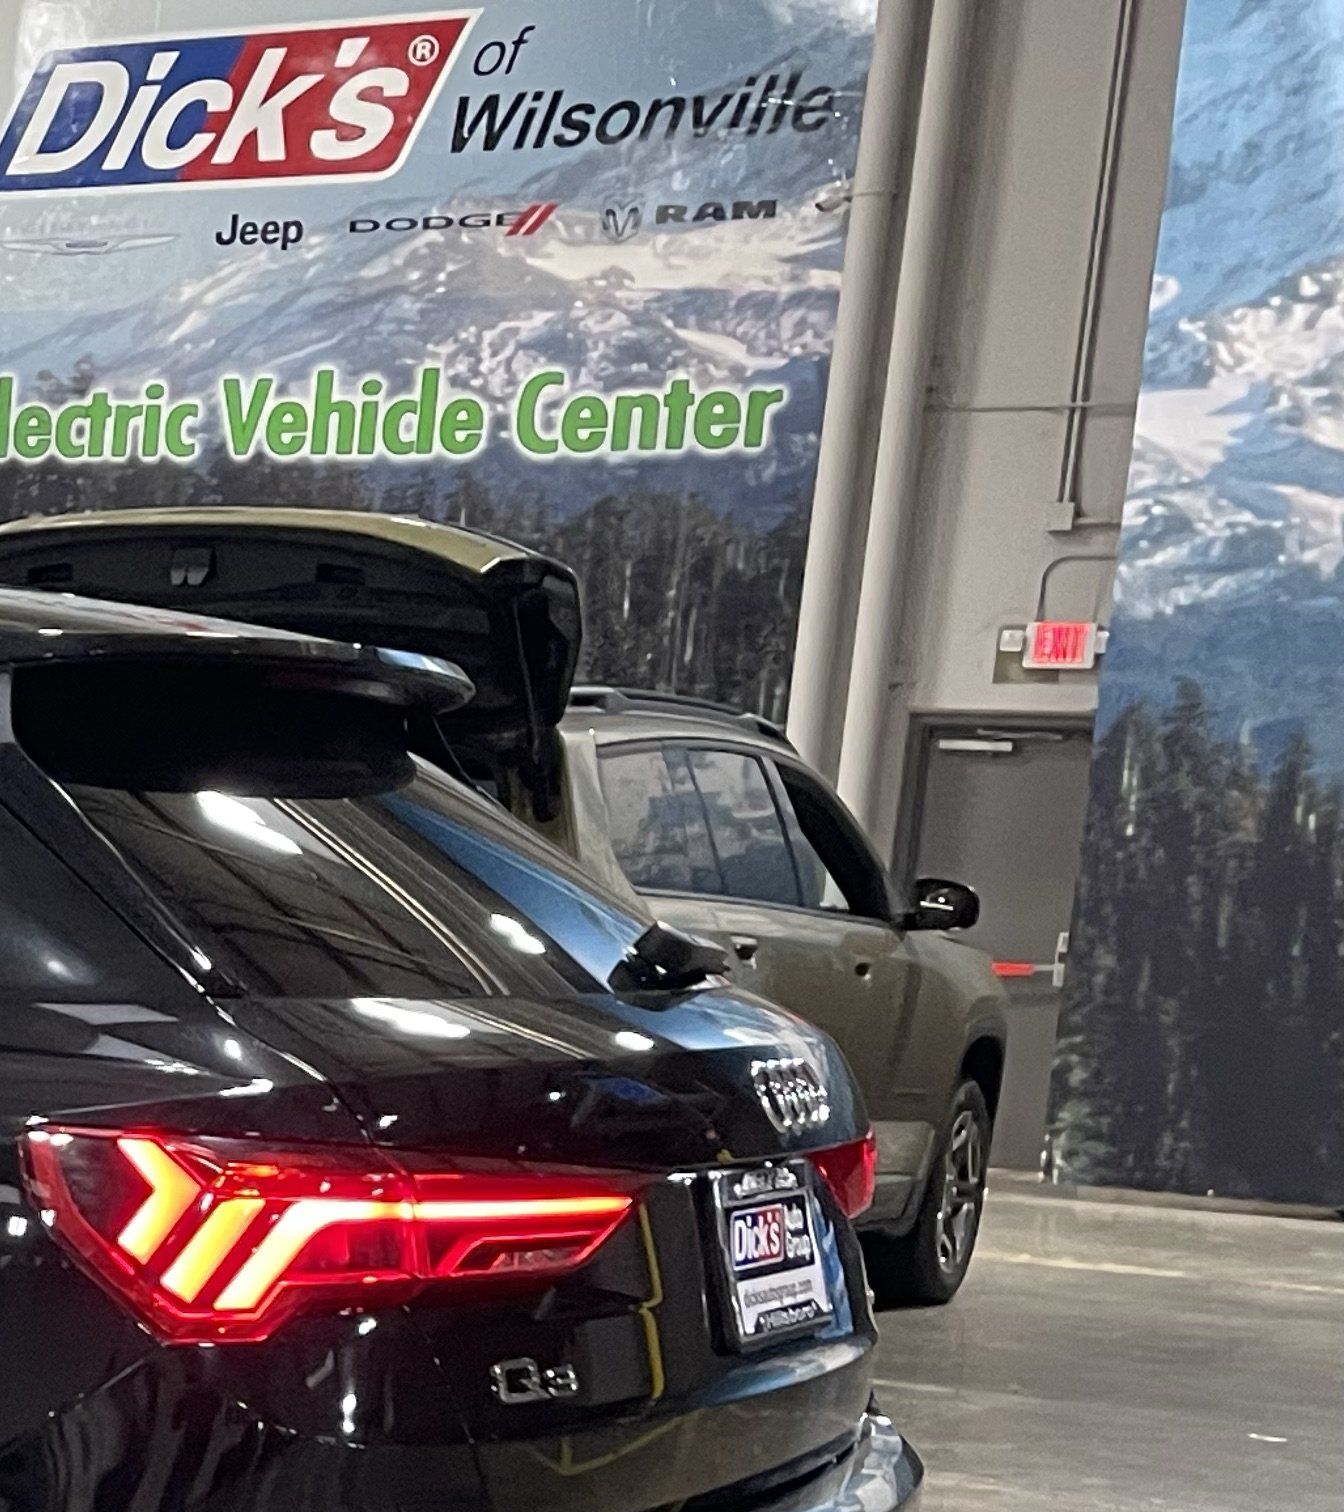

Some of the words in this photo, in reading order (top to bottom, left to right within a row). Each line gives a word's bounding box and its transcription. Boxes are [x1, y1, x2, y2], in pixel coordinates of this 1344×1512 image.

[472, 25, 536, 77] of
[6, 36, 410, 176] Dick's
[450, 70, 835, 153] Wilsonville
[215, 214, 305, 251] Jeep
[349, 211, 524, 233] DODGE
[654, 199, 777, 225] RAM
[222, 368, 486, 458] Vehicle
[515, 370, 785, 455] Center
[733, 1210, 781, 1262] Dick's
